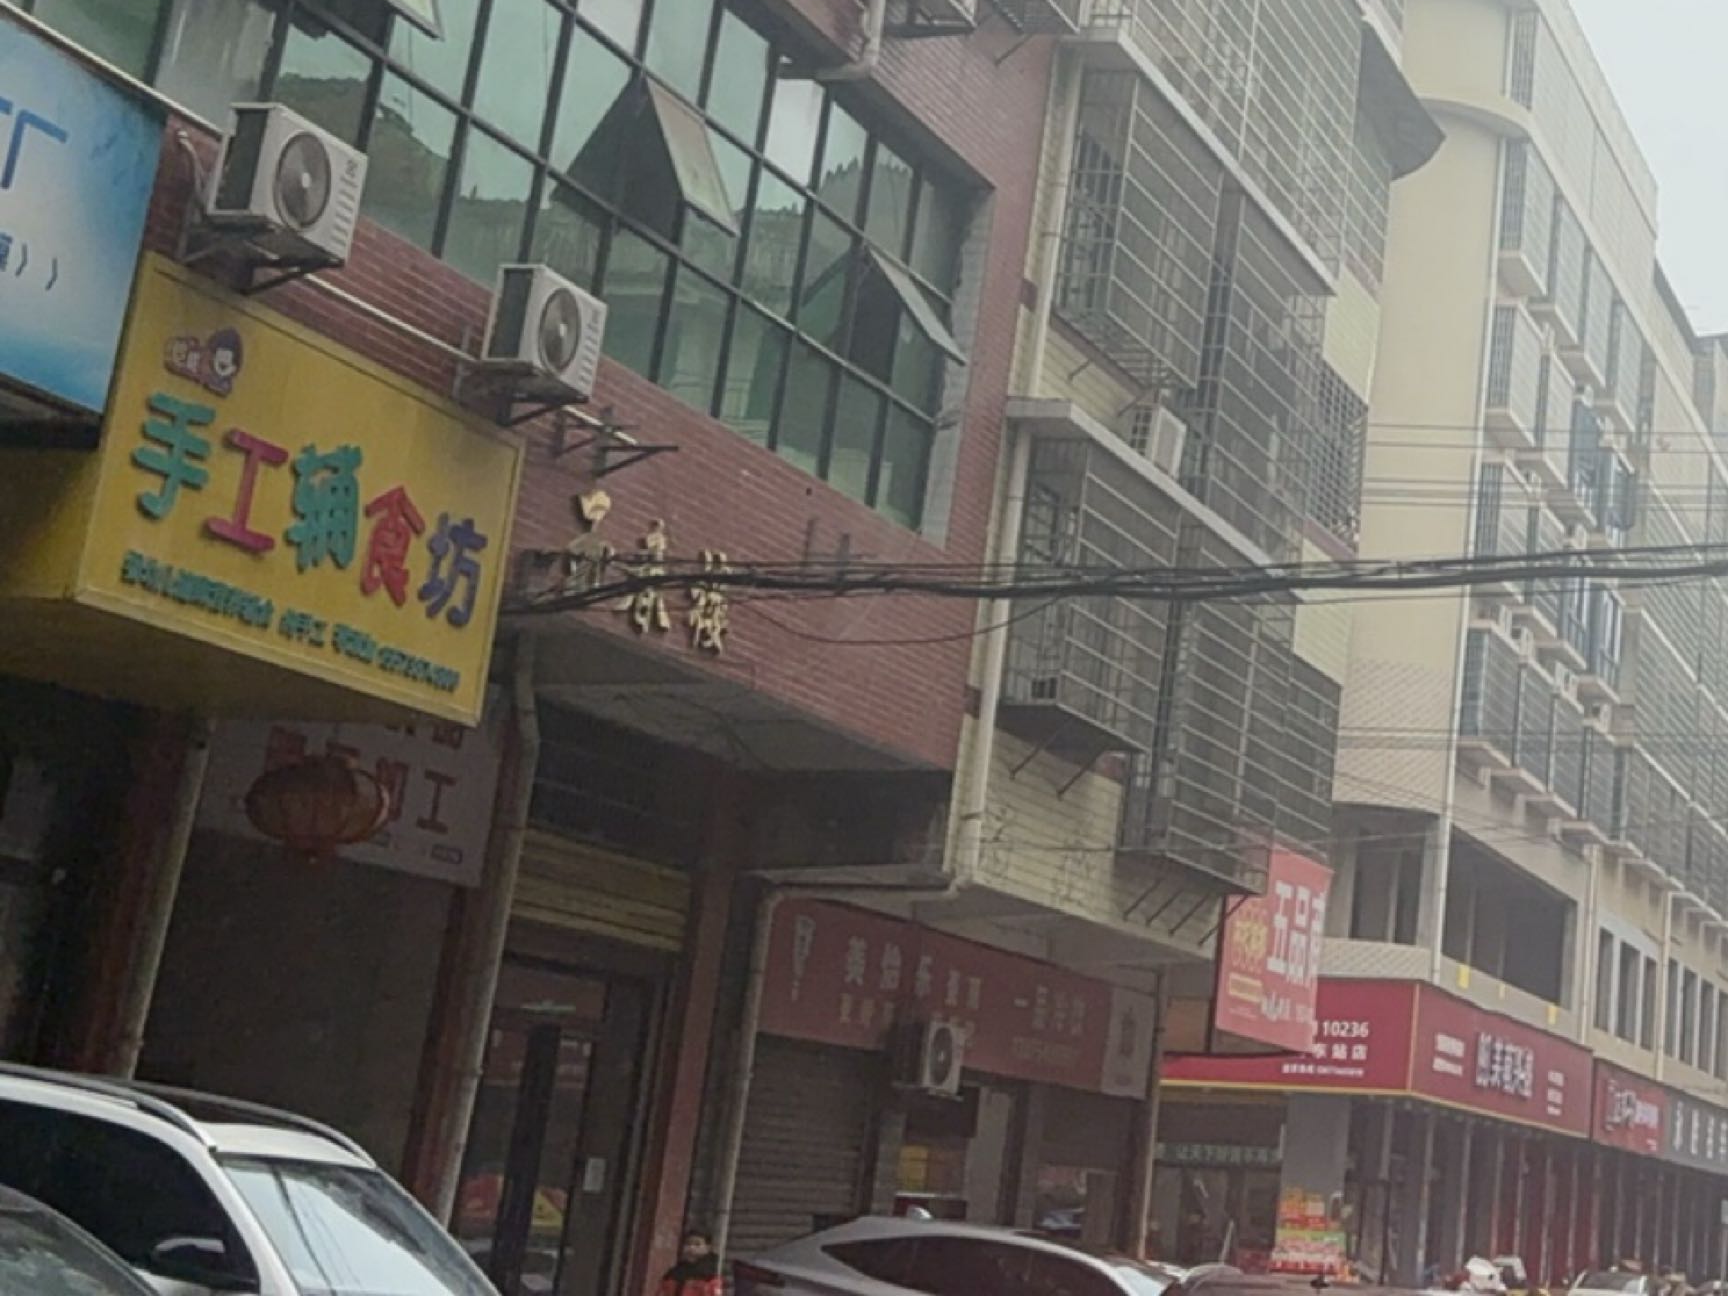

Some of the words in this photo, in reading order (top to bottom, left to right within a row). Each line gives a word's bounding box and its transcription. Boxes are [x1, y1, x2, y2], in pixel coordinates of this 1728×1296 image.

[132, 390, 488, 628] 手工辅食坊
